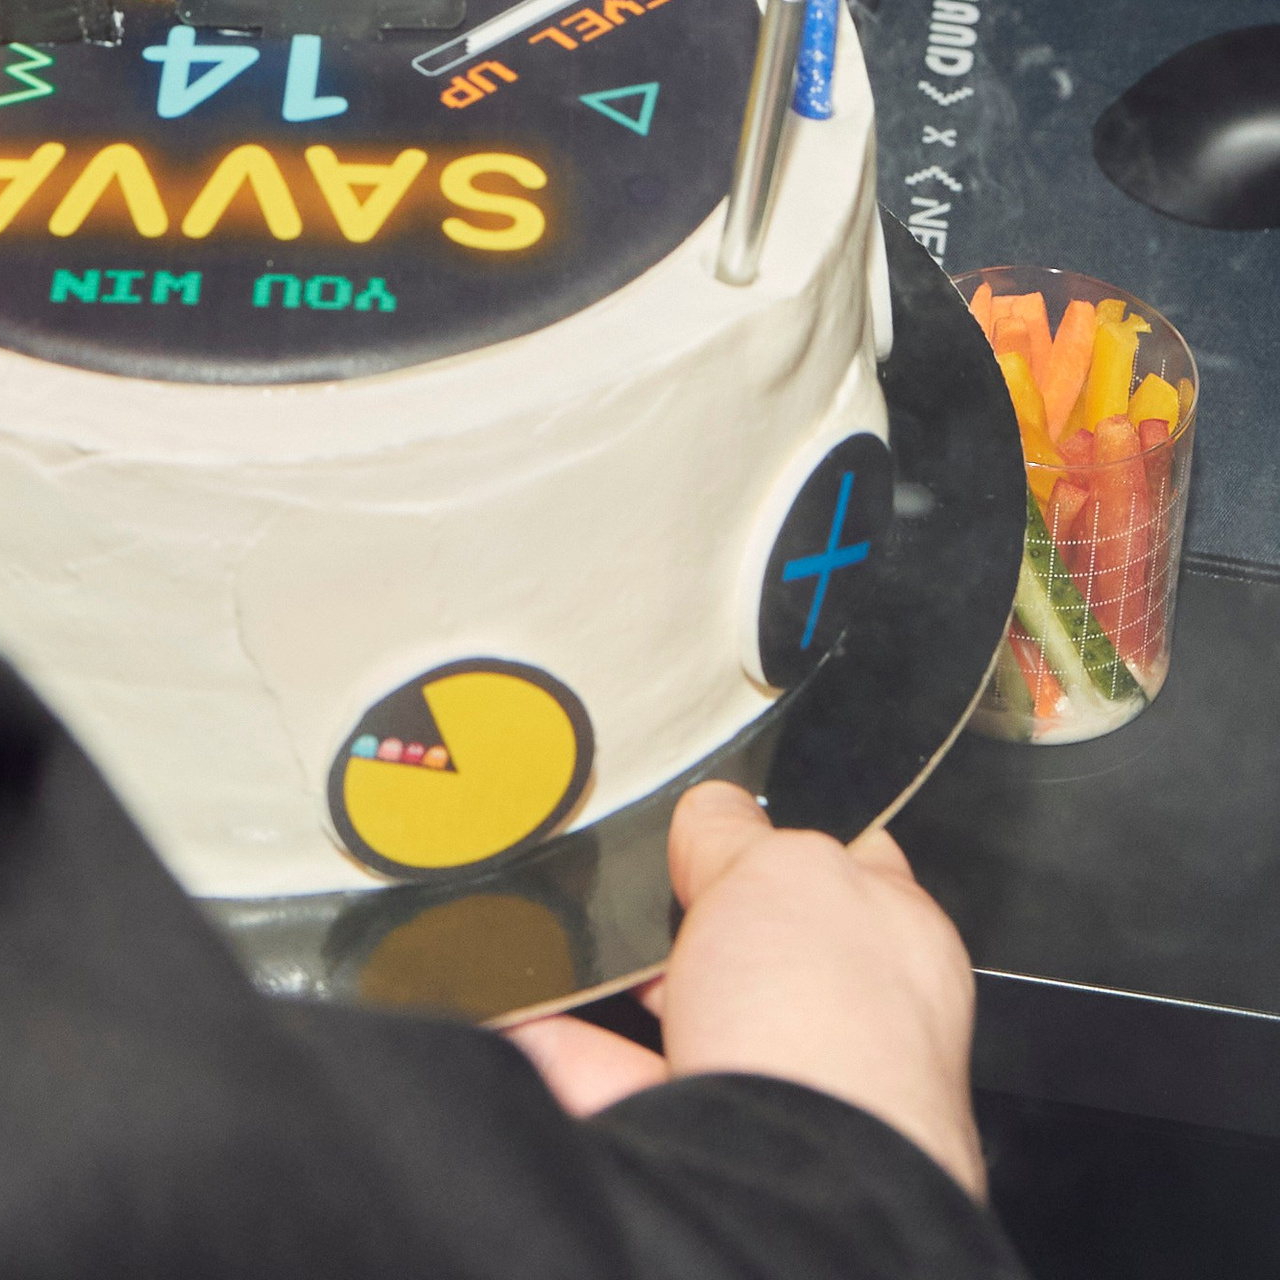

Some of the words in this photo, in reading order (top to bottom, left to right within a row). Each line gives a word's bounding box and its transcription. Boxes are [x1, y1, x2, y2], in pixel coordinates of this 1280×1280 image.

[142, 25, 349, 122] 14
[440, 61, 518, 110] UP
[49, 268, 203, 306] WIN
[251, 272, 398, 314] YOU
